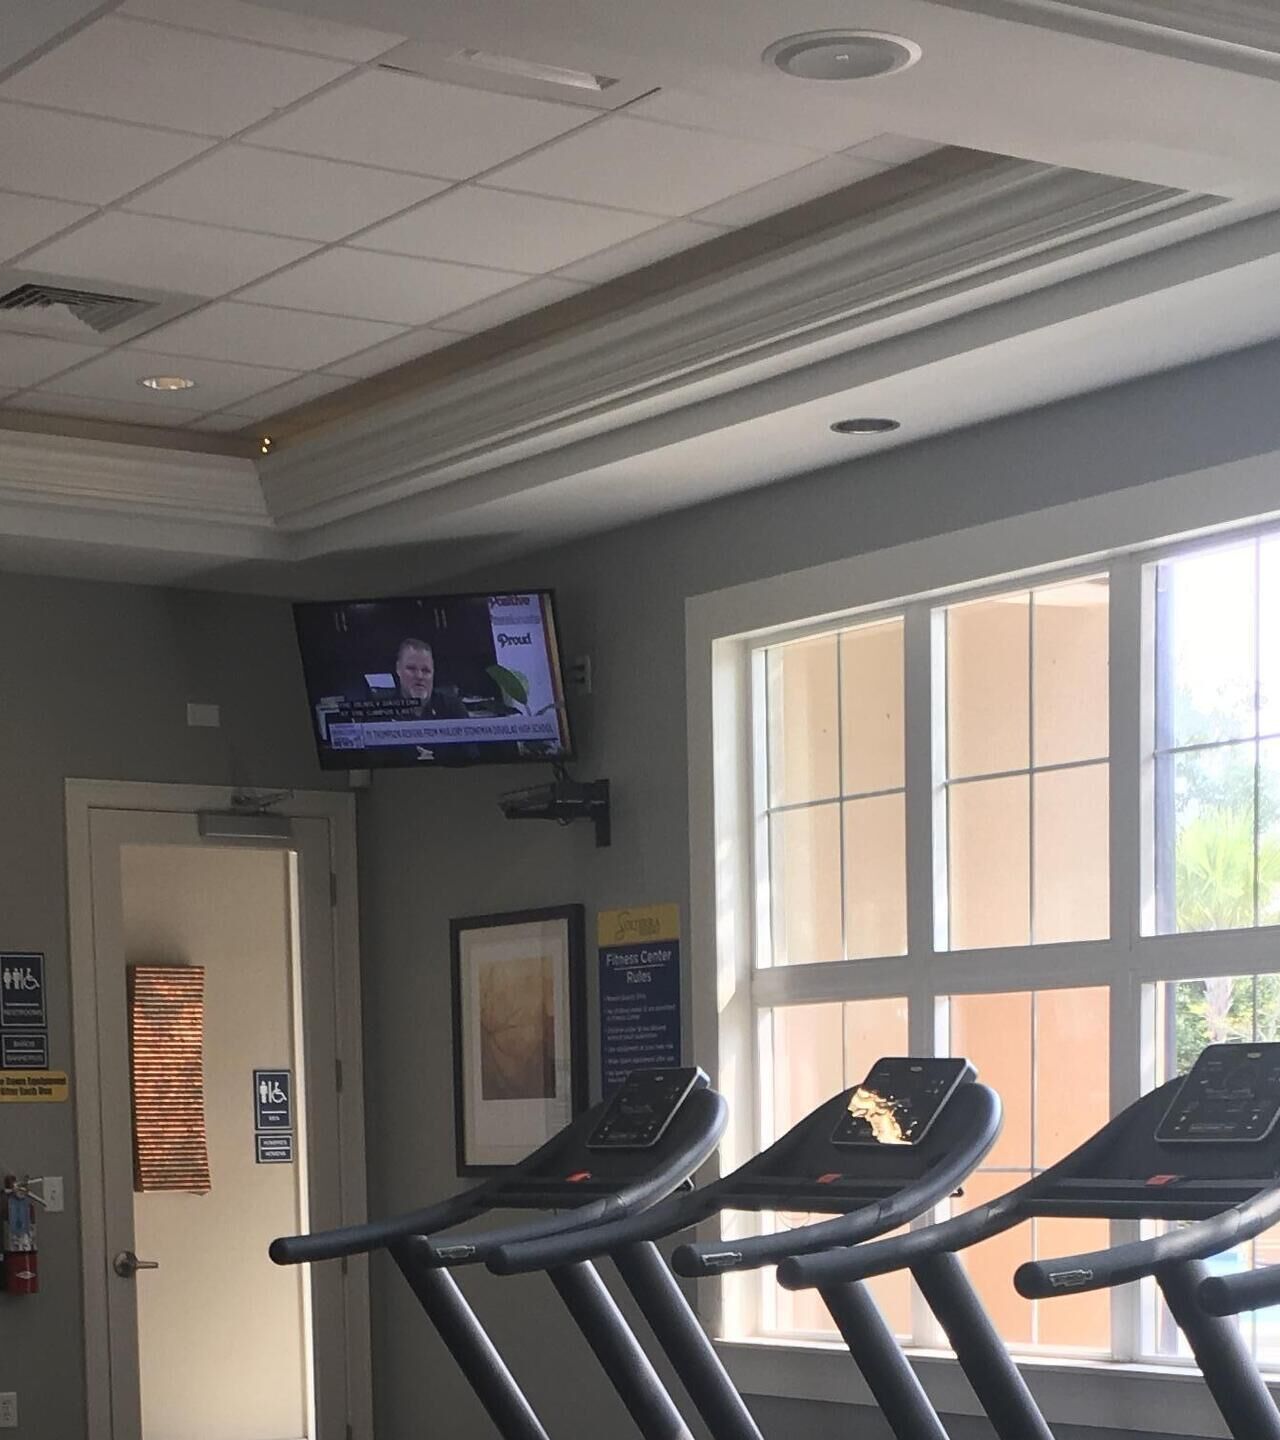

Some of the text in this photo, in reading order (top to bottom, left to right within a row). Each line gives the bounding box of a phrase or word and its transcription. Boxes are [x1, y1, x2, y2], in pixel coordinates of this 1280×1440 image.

[497, 633, 532, 648] Proud
[606, 949, 672, 967] Fitness Center
[626, 970, 652, 984] Rules
